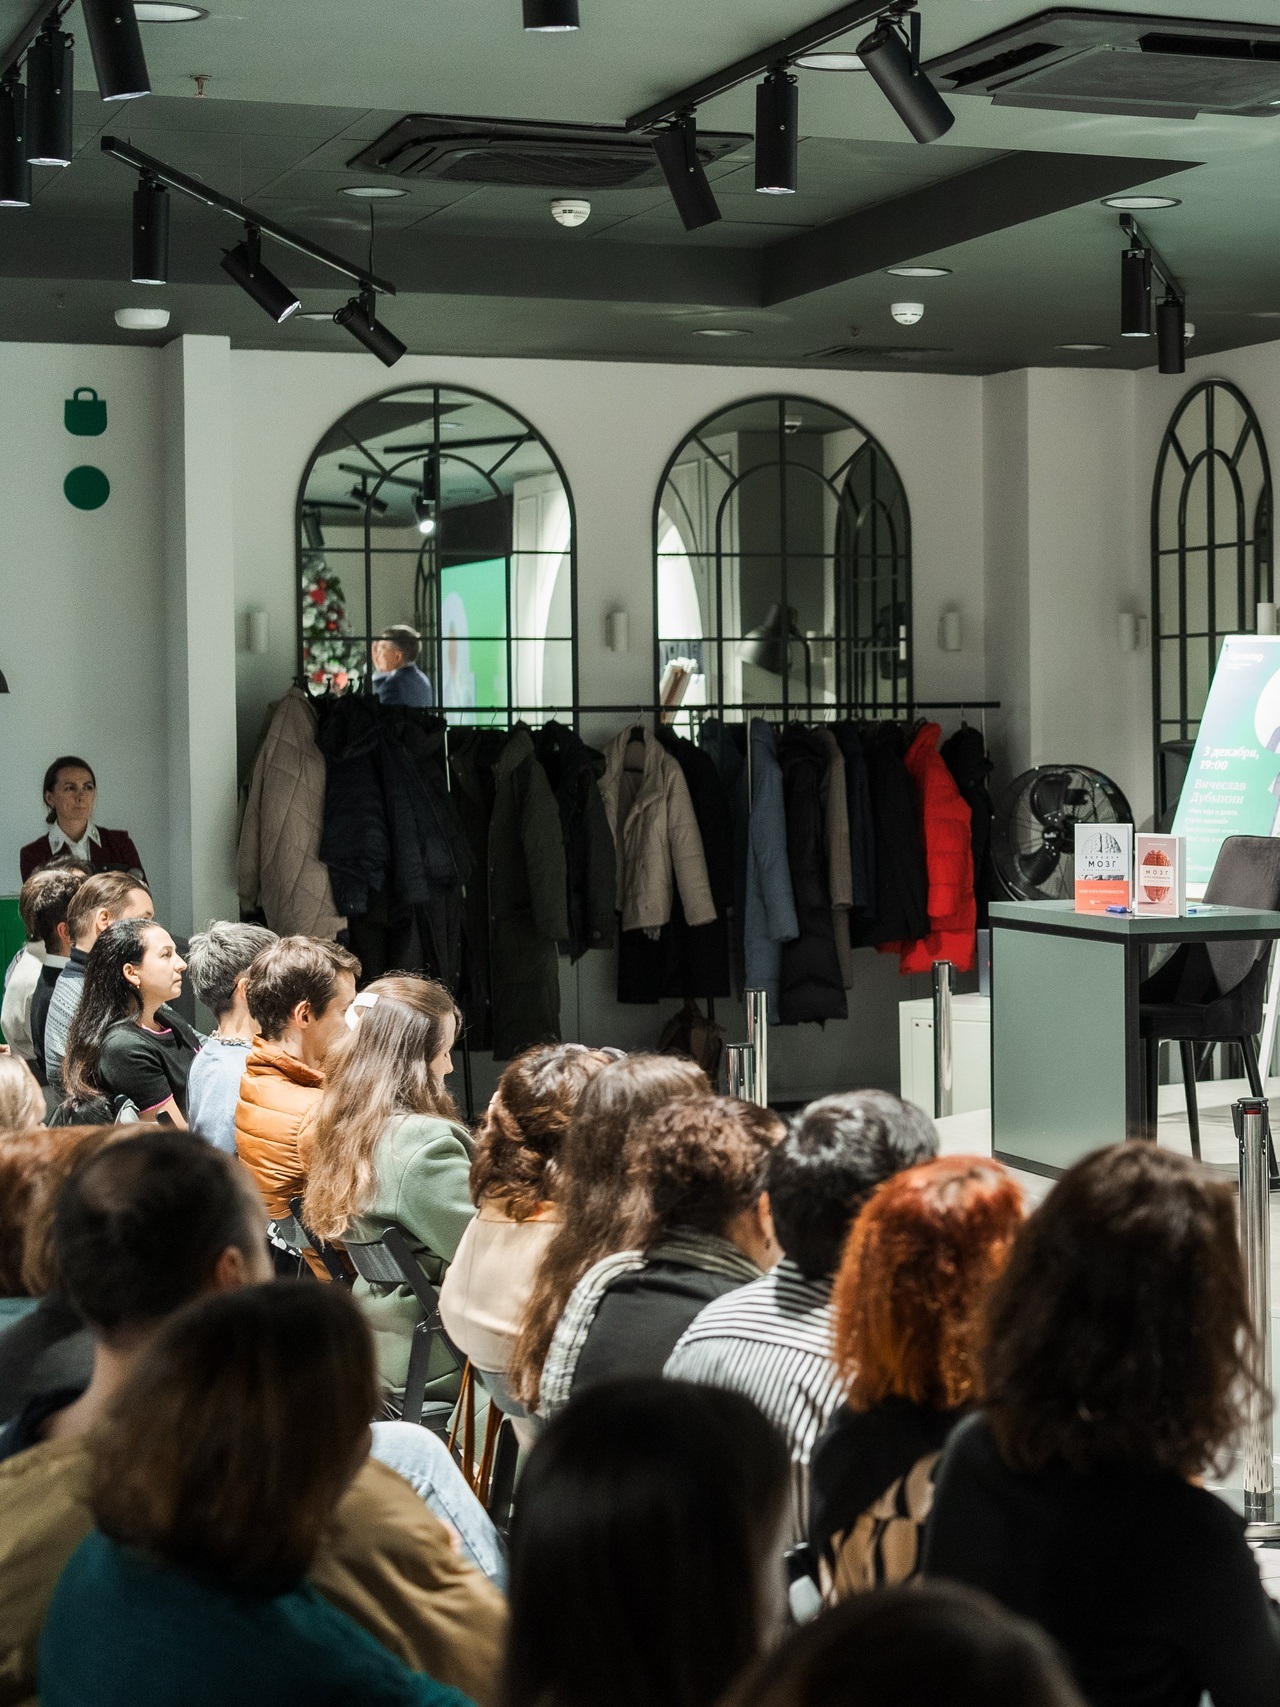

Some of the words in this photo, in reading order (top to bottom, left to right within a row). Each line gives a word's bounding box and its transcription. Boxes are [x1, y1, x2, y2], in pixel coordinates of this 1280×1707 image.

[1210, 745, 1260, 760] декабря,
[1199, 759, 1229, 770] 19:00
[1193, 778, 1247, 791] Вячеслав
[1188, 791, 1245, 806] Дубынин
[1088, 860, 1117, 868] МОЗГ
